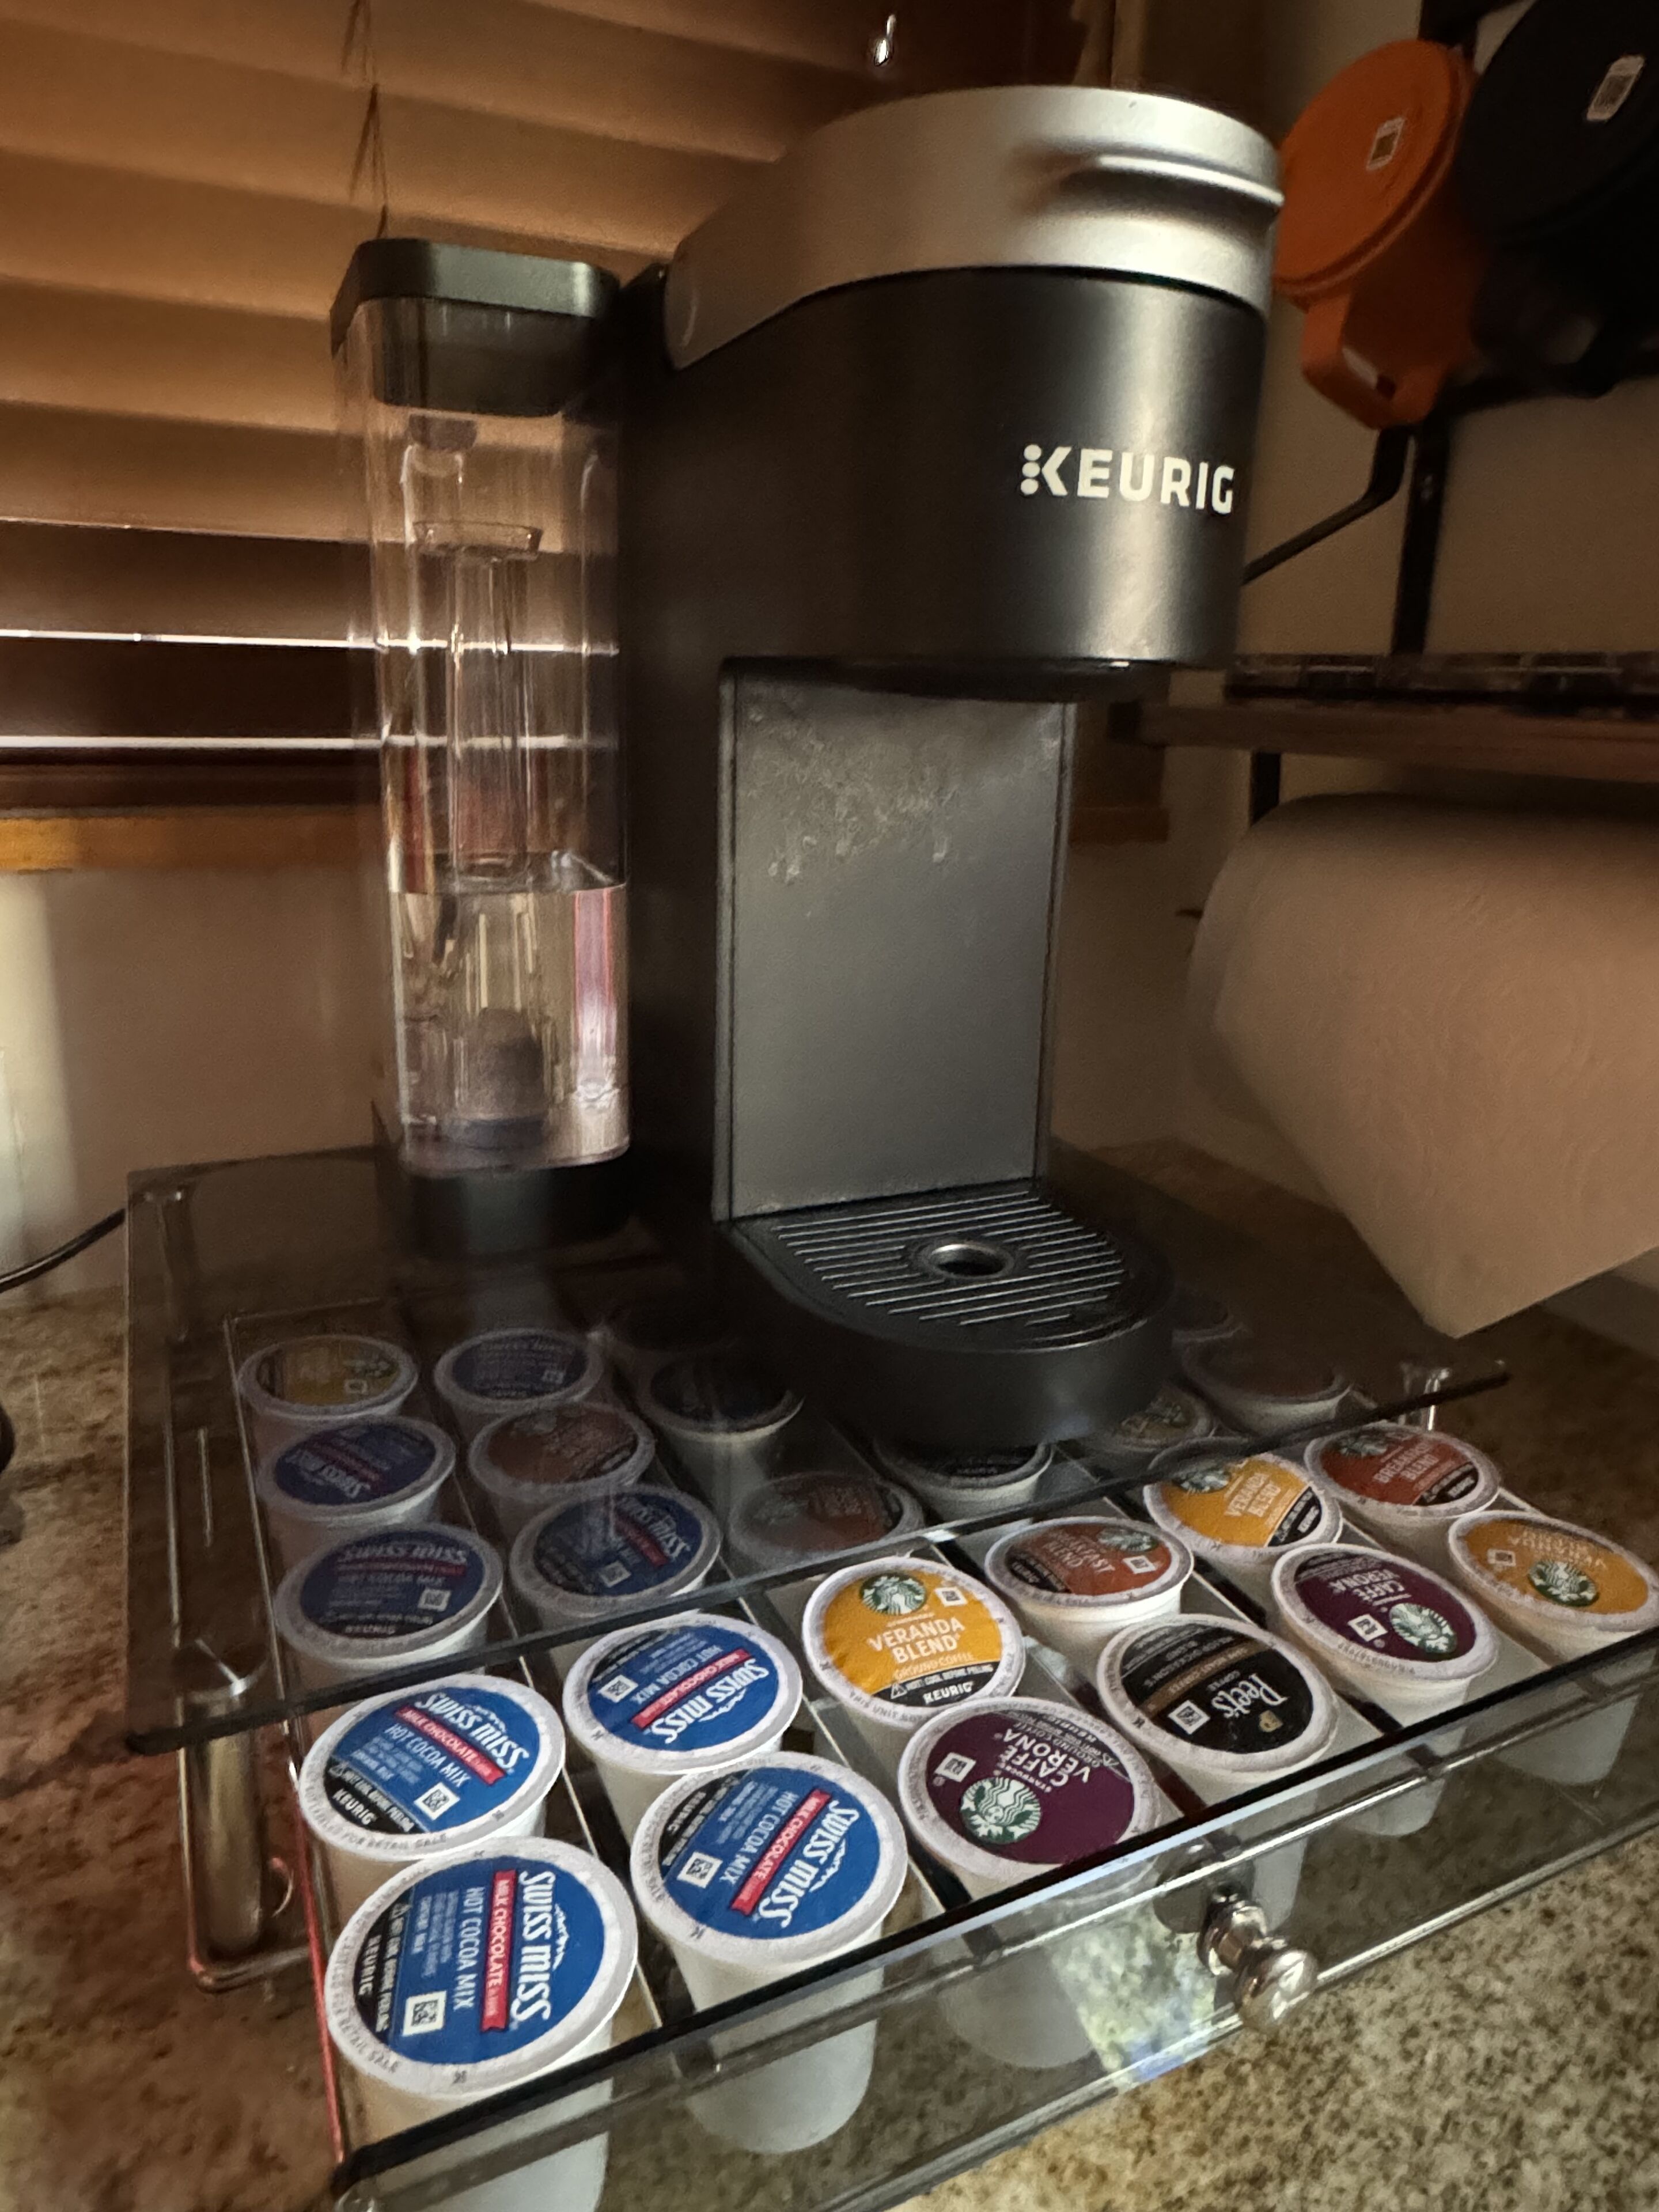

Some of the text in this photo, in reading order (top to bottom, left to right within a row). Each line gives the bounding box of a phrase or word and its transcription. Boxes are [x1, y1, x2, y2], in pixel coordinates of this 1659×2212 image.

[1020, 444, 1235, 514] KEURIG
[866, 1616, 965, 1652] VERANDA
[650, 1658, 769, 1744] SWISS MISS
[923, 1680, 975, 1706] KEURIG
[1211, 1673, 1289, 1719] Peet's
[384, 1723, 407, 1743] HOT
[405, 1736, 446, 1770] COCOA
[440, 1762, 472, 1788] MIX
[414, 1692, 483, 1733] SWISS
[469, 1721, 529, 1771] MISS
[1003, 1728, 1091, 1783] VERONA
[332, 1787, 378, 1825] KEURIG
[744, 1810, 776, 1851] COCOA
[770, 1790, 798, 1816] HOT
[719, 1849, 752, 1885] MIX
[753, 1813, 804, 1879] CHOCOLATE
[758, 1799, 860, 1929] SWISS MISS
[495, 1879, 512, 1906] MILK
[453, 1886, 486, 2012] HOT COCOA MIX
[487, 1907, 507, 1988] CHOCOLATE
[510, 1870, 556, 2022] SWISS MISS
